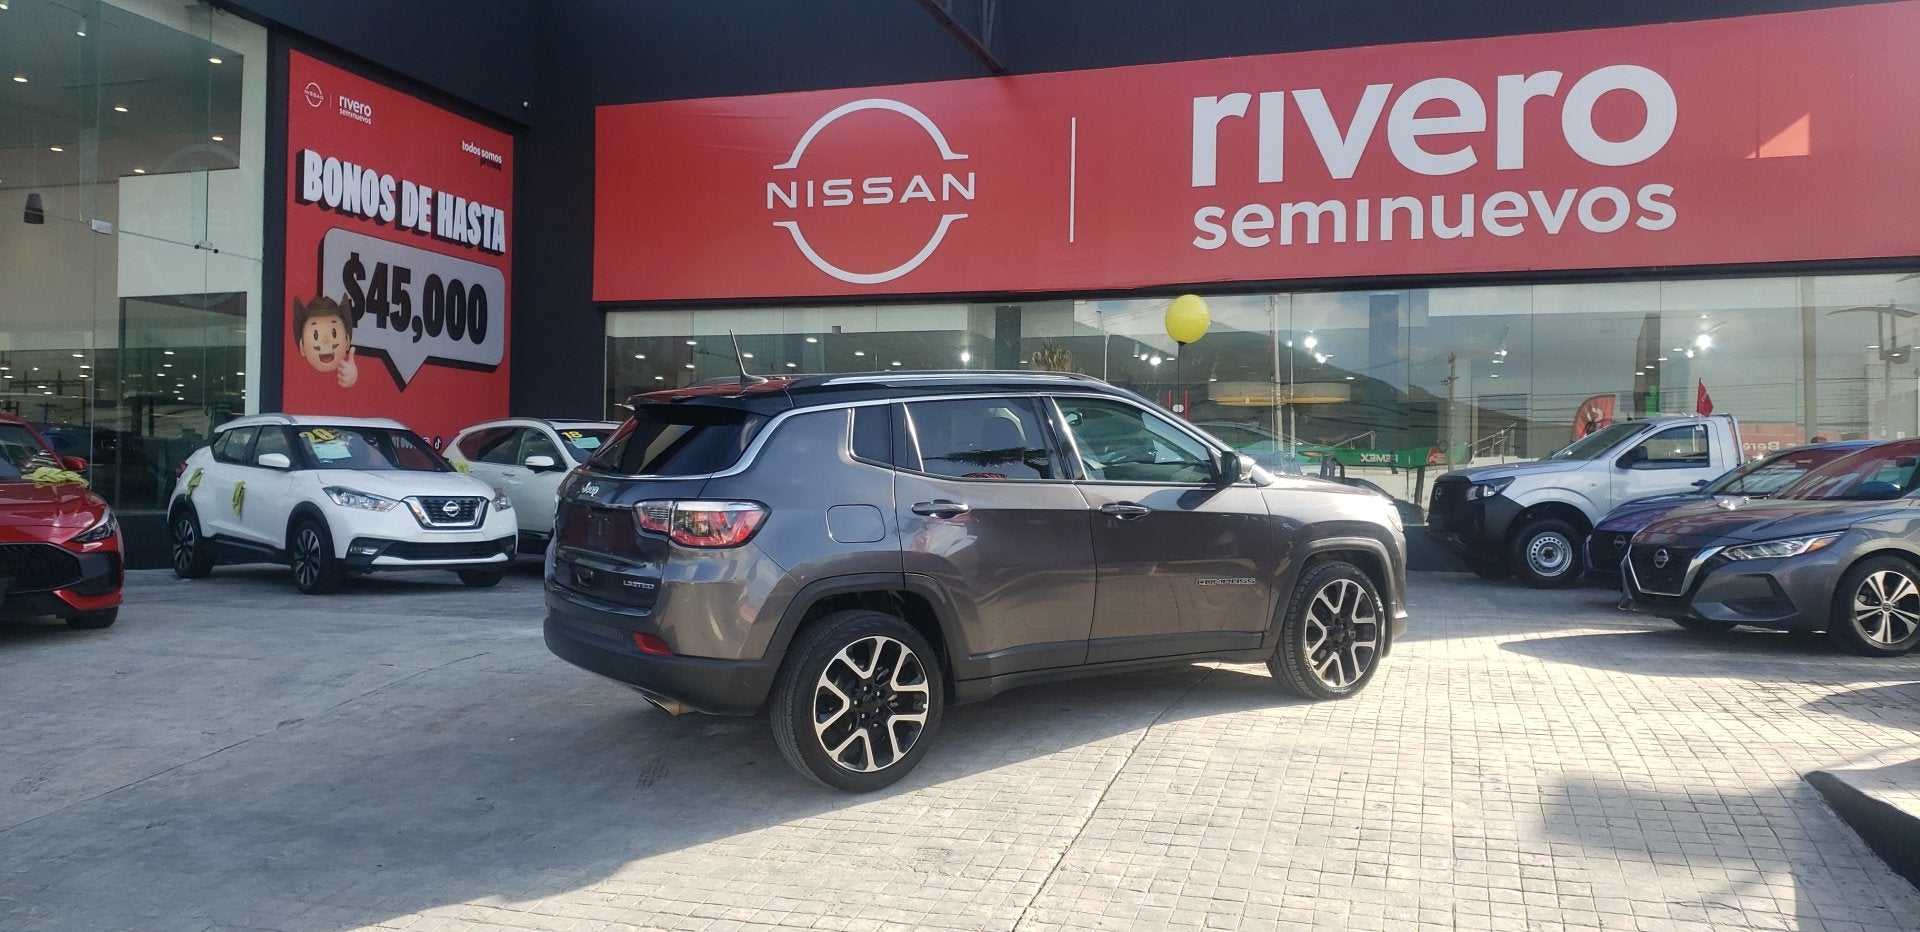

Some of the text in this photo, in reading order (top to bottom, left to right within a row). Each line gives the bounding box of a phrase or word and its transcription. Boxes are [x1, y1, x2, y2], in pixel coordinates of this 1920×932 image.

[339, 95, 372, 117] rivero
[1192, 64, 1678, 187] rivero
[461, 140, 502, 164] todos somos
[302, 148, 506, 254] BONOS DE HASTA
[766, 172, 975, 209] NISSAN
[1192, 183, 1677, 250] seminuevos
[342, 251, 488, 345] $45,000
[560, 430, 583, 440] 18
[581, 481, 600, 498] Jeep
